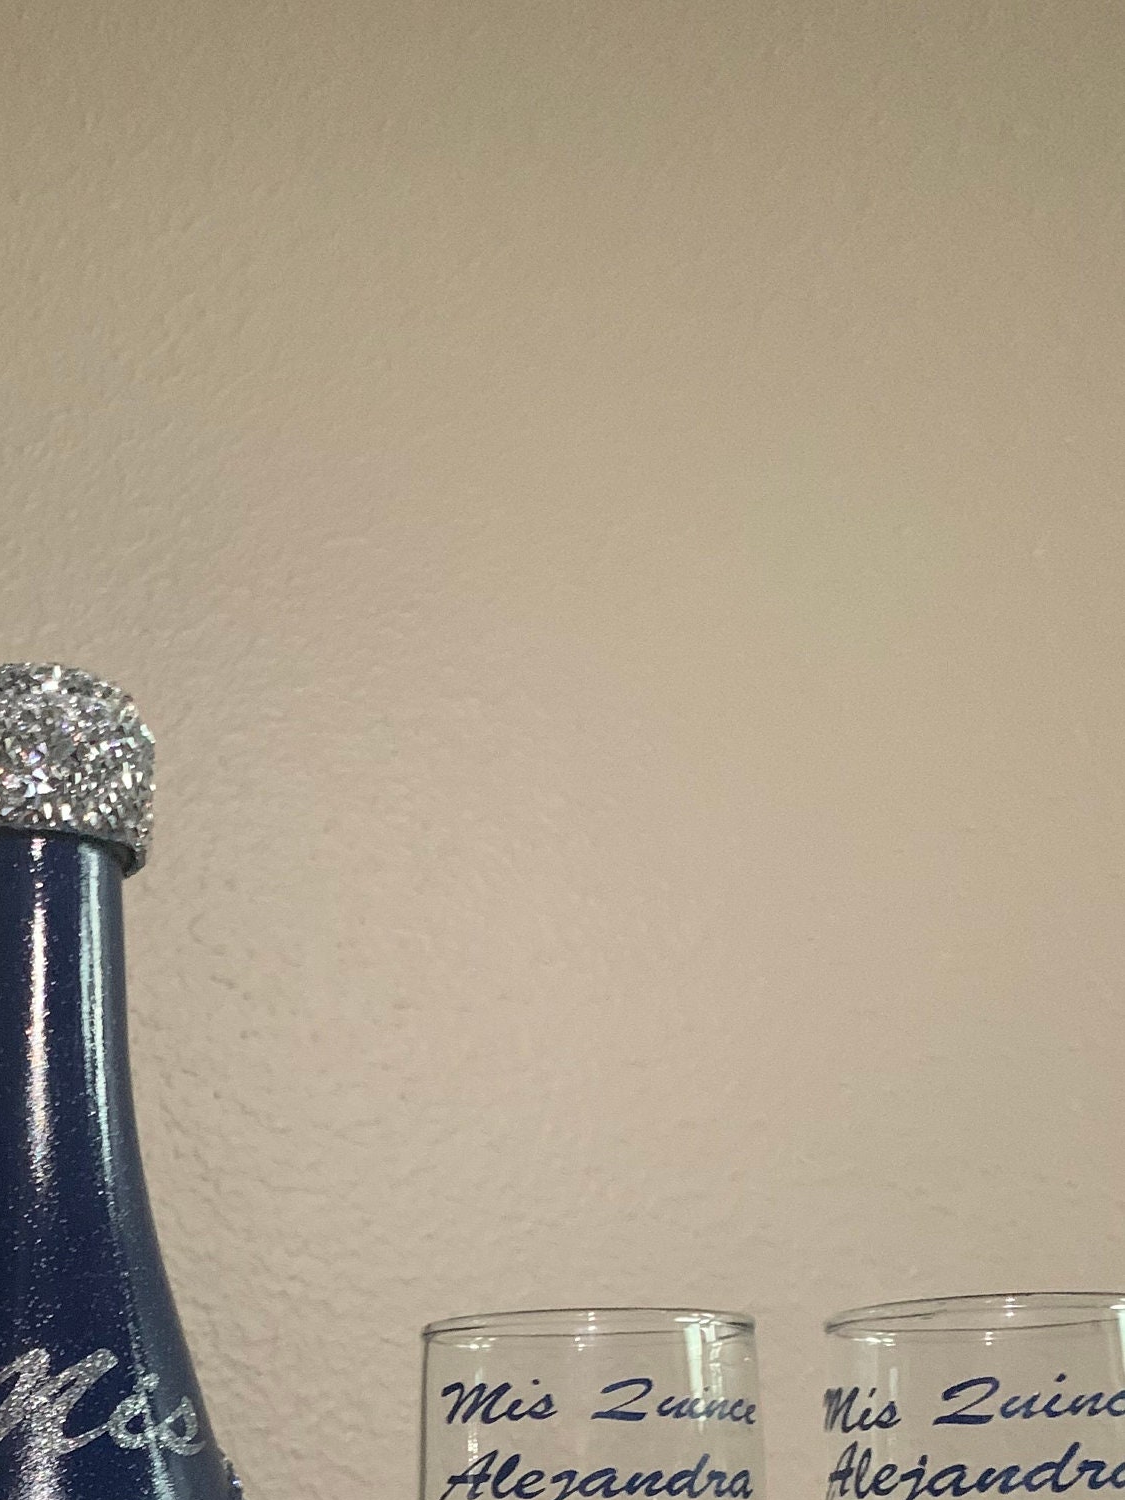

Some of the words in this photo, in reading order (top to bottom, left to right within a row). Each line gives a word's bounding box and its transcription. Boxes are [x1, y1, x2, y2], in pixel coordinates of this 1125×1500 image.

[441, 1379, 557, 1424] Mis
[591, 1378, 756, 1425] Quince
[823, 1386, 901, 1433] Mis
